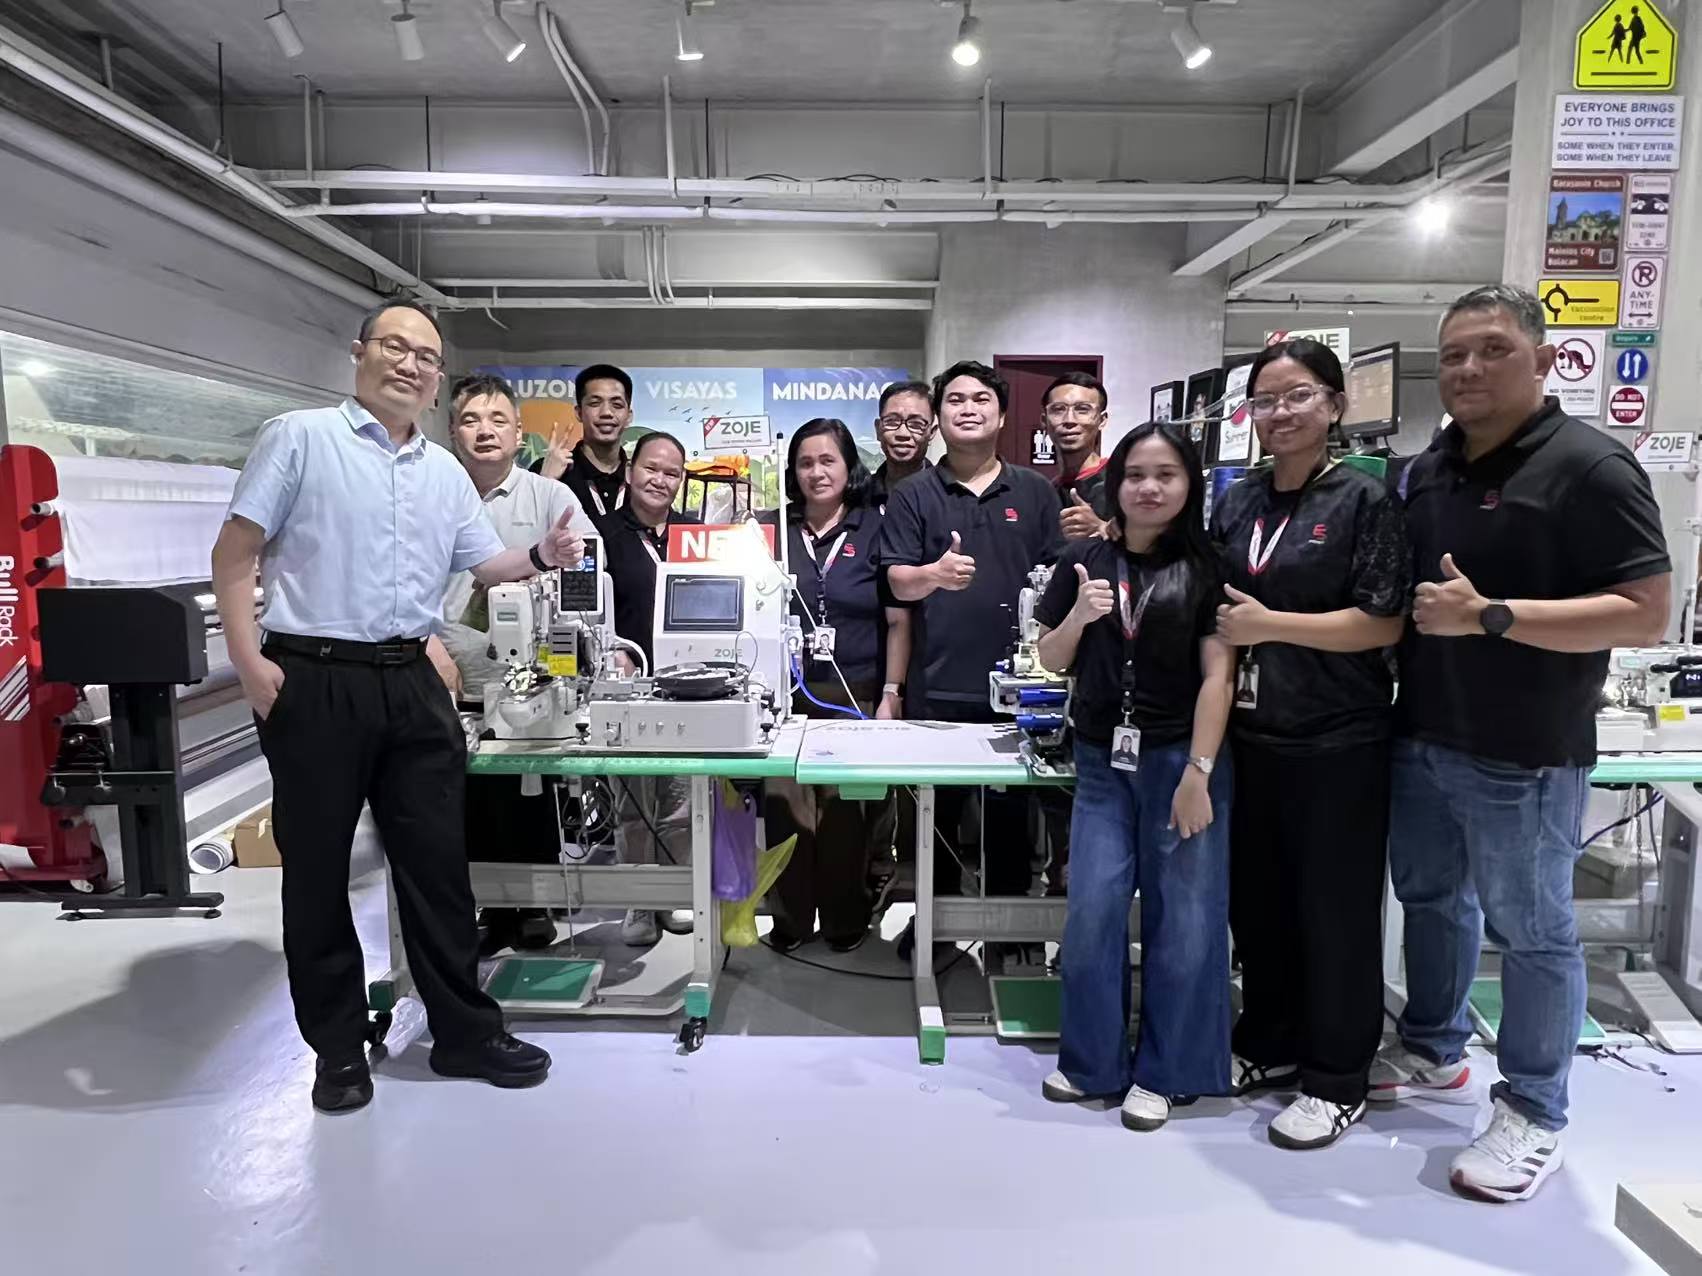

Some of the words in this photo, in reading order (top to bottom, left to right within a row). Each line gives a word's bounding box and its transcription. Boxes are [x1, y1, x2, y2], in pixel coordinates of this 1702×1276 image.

[1564, 102, 1627, 113] EVERYONE
[1631, 103, 1675, 113] BRINGS
[1560, 117, 1583, 128] JOY
[1587, 118, 1602, 128] TO
[1606, 118, 1631, 128] THIS
[1634, 118, 1676, 128] OFFICE
[1557, 142, 1584, 150] SOME
[1586, 142, 1614, 150] WHEN
[1617, 142, 1640, 151] THEY
[1643, 142, 1674, 151] ENTER
[1556, 153, 1583, 162] SOME
[1586, 153, 1614, 162] WHEN
[1616, 153, 1640, 162] THEY
[1642, 154, 1672, 162] LEAVE
[1630, 301, 1653, 309] TIME
[506, 379, 577, 398] UZO
[645, 380, 737, 399] VISAYAS
[720, 420, 761, 437] ZOJE
[1649, 436, 1686, 453] ZOJE
[714, 648, 743, 659] ZOJE
